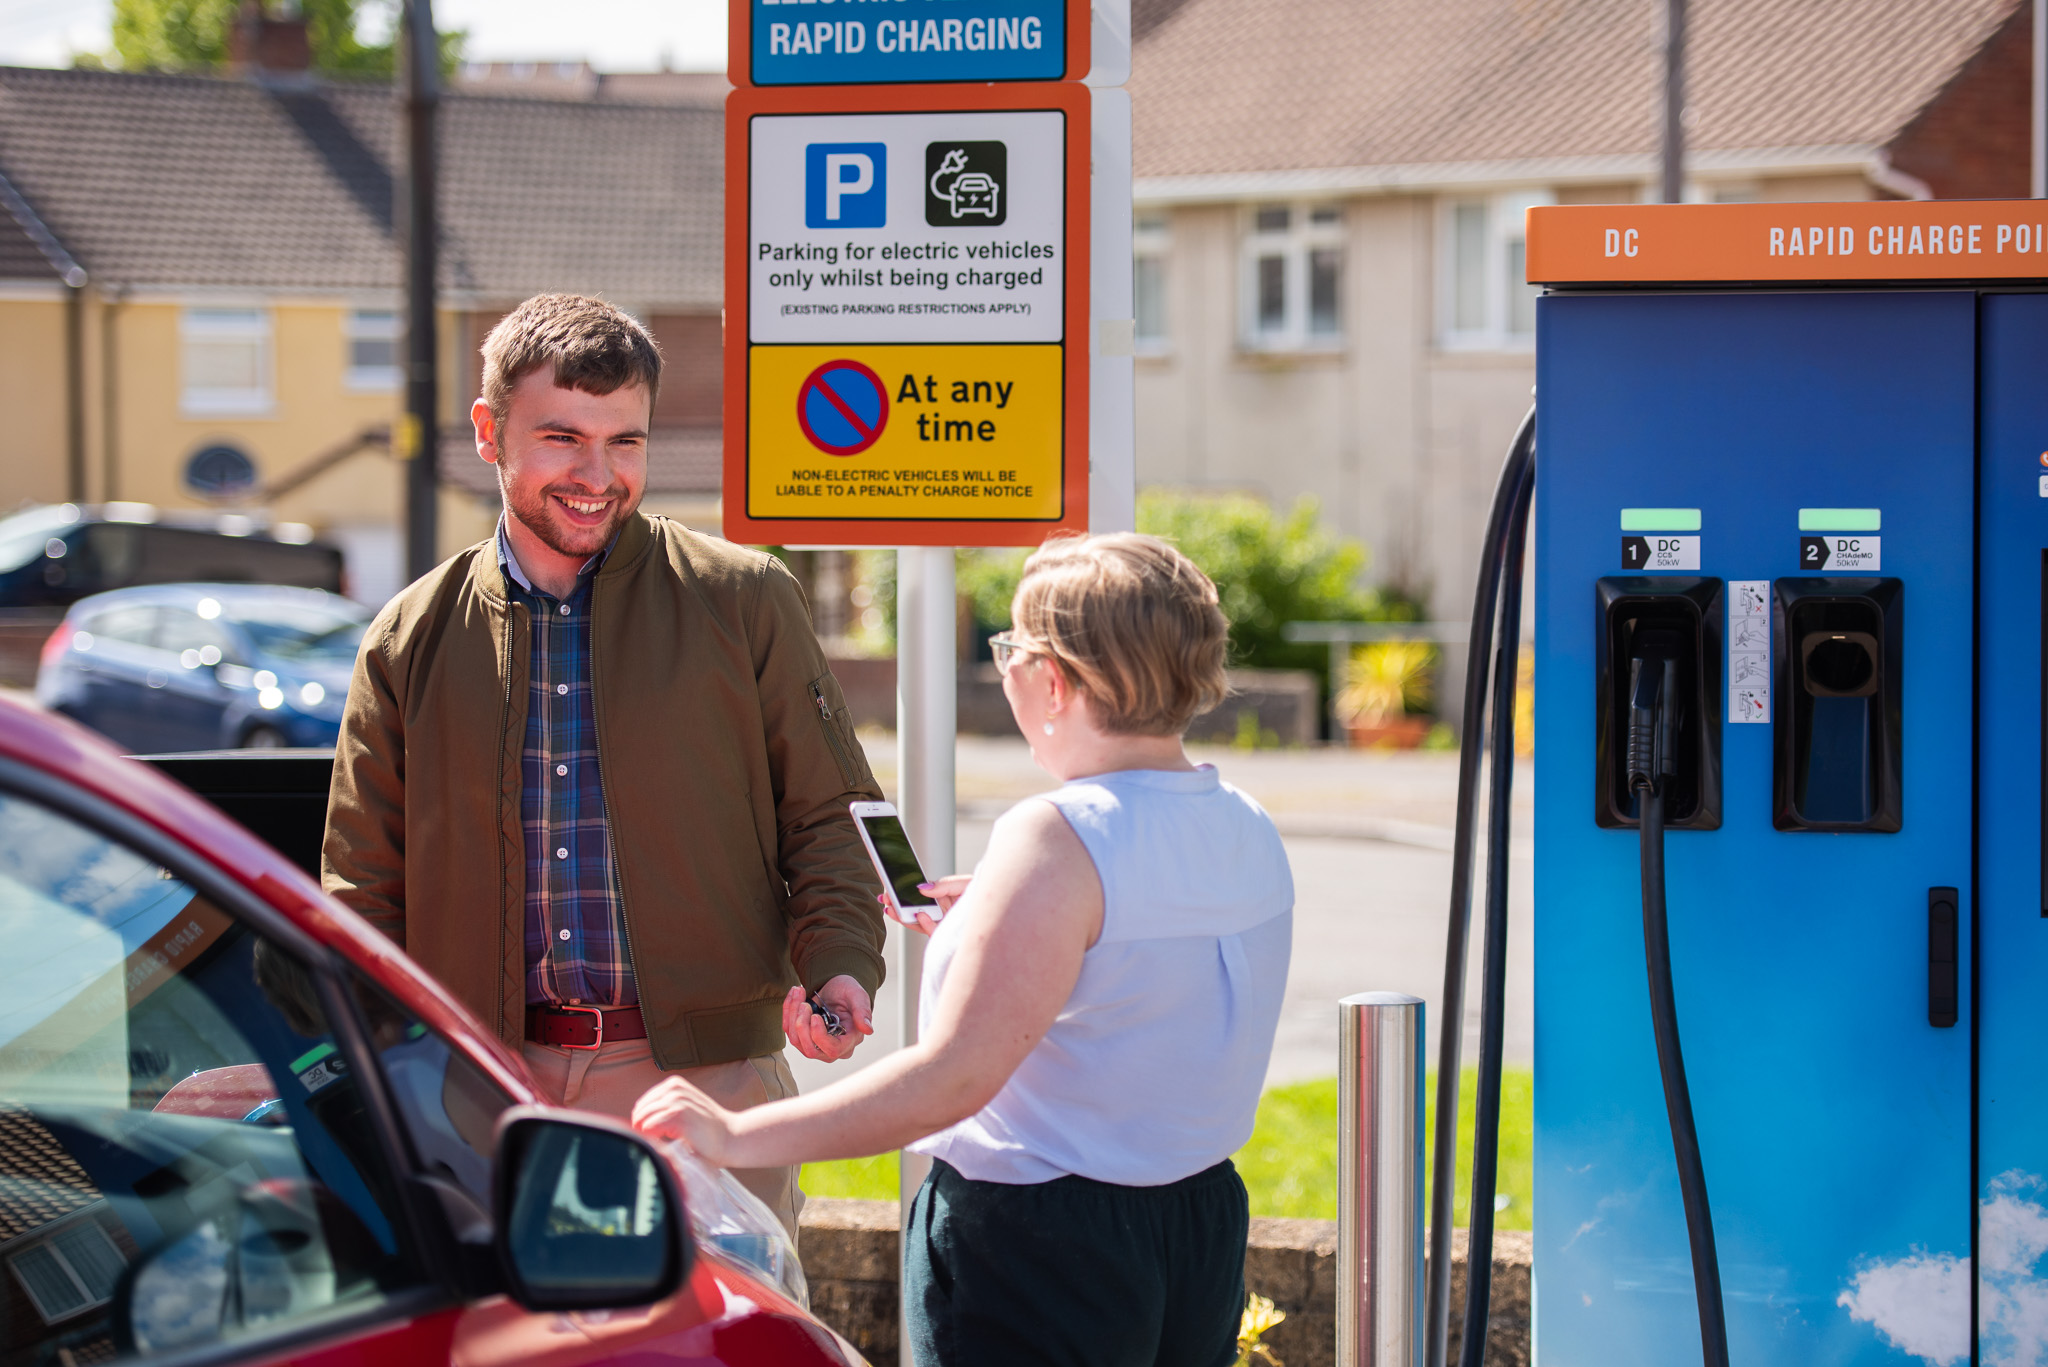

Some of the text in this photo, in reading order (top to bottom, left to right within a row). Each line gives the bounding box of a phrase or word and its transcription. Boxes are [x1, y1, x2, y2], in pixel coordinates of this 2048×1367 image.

[770, 16, 1042, 56] RAPID CHARGING
[825, 153, 874, 221] P
[1604, 228, 1639, 258] DC
[1769, 224, 2048, 257] RAPID CHARGE POI
[759, 240, 1054, 265] Parking for electric vehicles
[769, 267, 1043, 291] only whilst being charged
[781, 303, 1032, 317] (EXISTING PARKING RESTRICTIONS APPLY)
[896, 374, 1014, 409] At any
[916, 412, 996, 442] time
[791, 469, 1016, 482] NON-ELECTRIC VEHICLES WILL BE
[775, 484, 1033, 498] LIABLE TO A PENALTY CHARGE NOTICE
[1628, 544, 1637, 561] 1
[1658, 539, 1681, 552] DC
[1806, 544, 1819, 561] 2
[1837, 539, 1860, 552] DC
[1657, 559, 1680, 567] 50kW
[1836, 559, 1860, 567] 50kW
